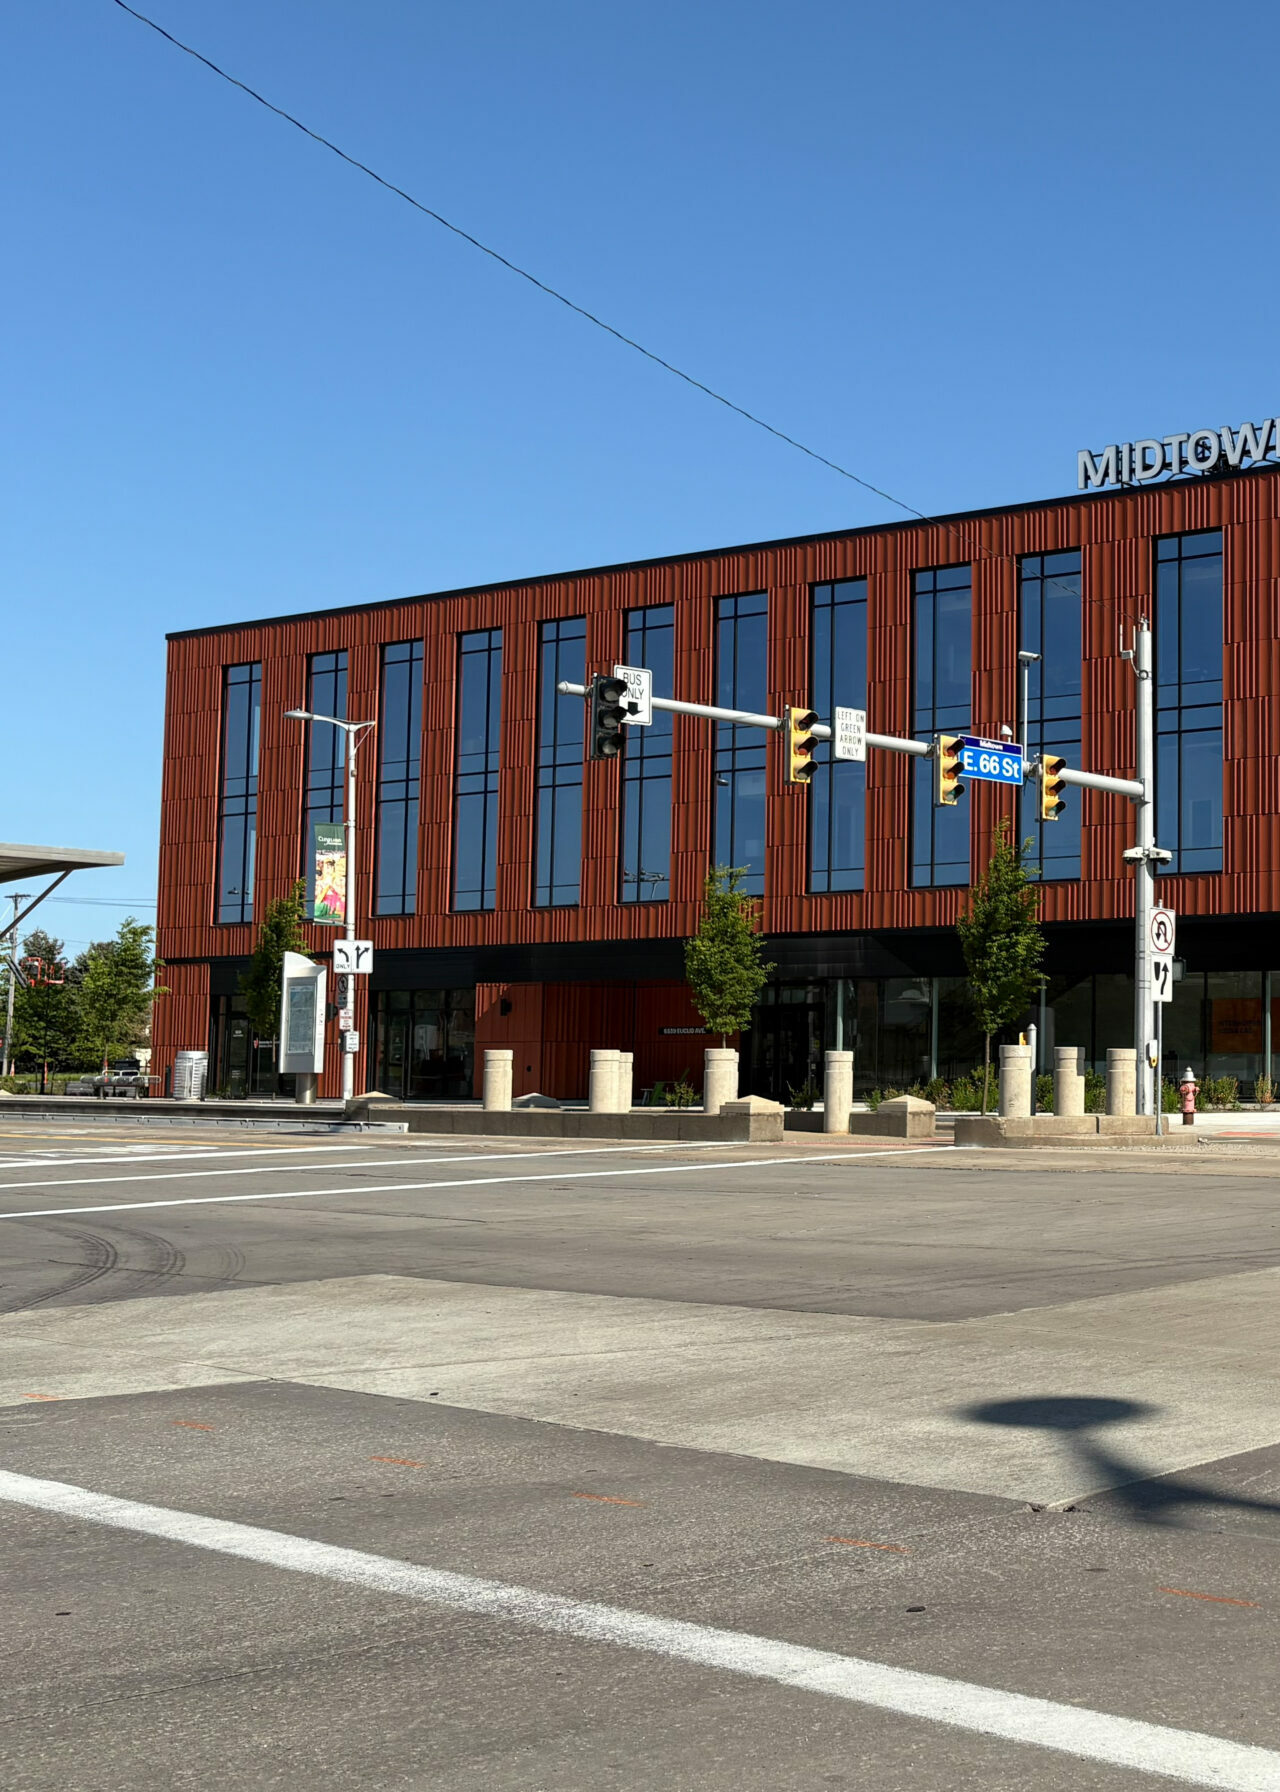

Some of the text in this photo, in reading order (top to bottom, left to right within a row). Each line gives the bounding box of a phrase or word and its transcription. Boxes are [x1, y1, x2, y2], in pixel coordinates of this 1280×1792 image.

[624, 672, 642, 686] BUS
[837, 710, 864, 722] LEFT ON
[840, 723, 861, 734] GREEN
[840, 734, 862, 745] ARROW
[842, 745, 859, 757] ONLY
[963, 751, 1020, 778] E. 66 St
